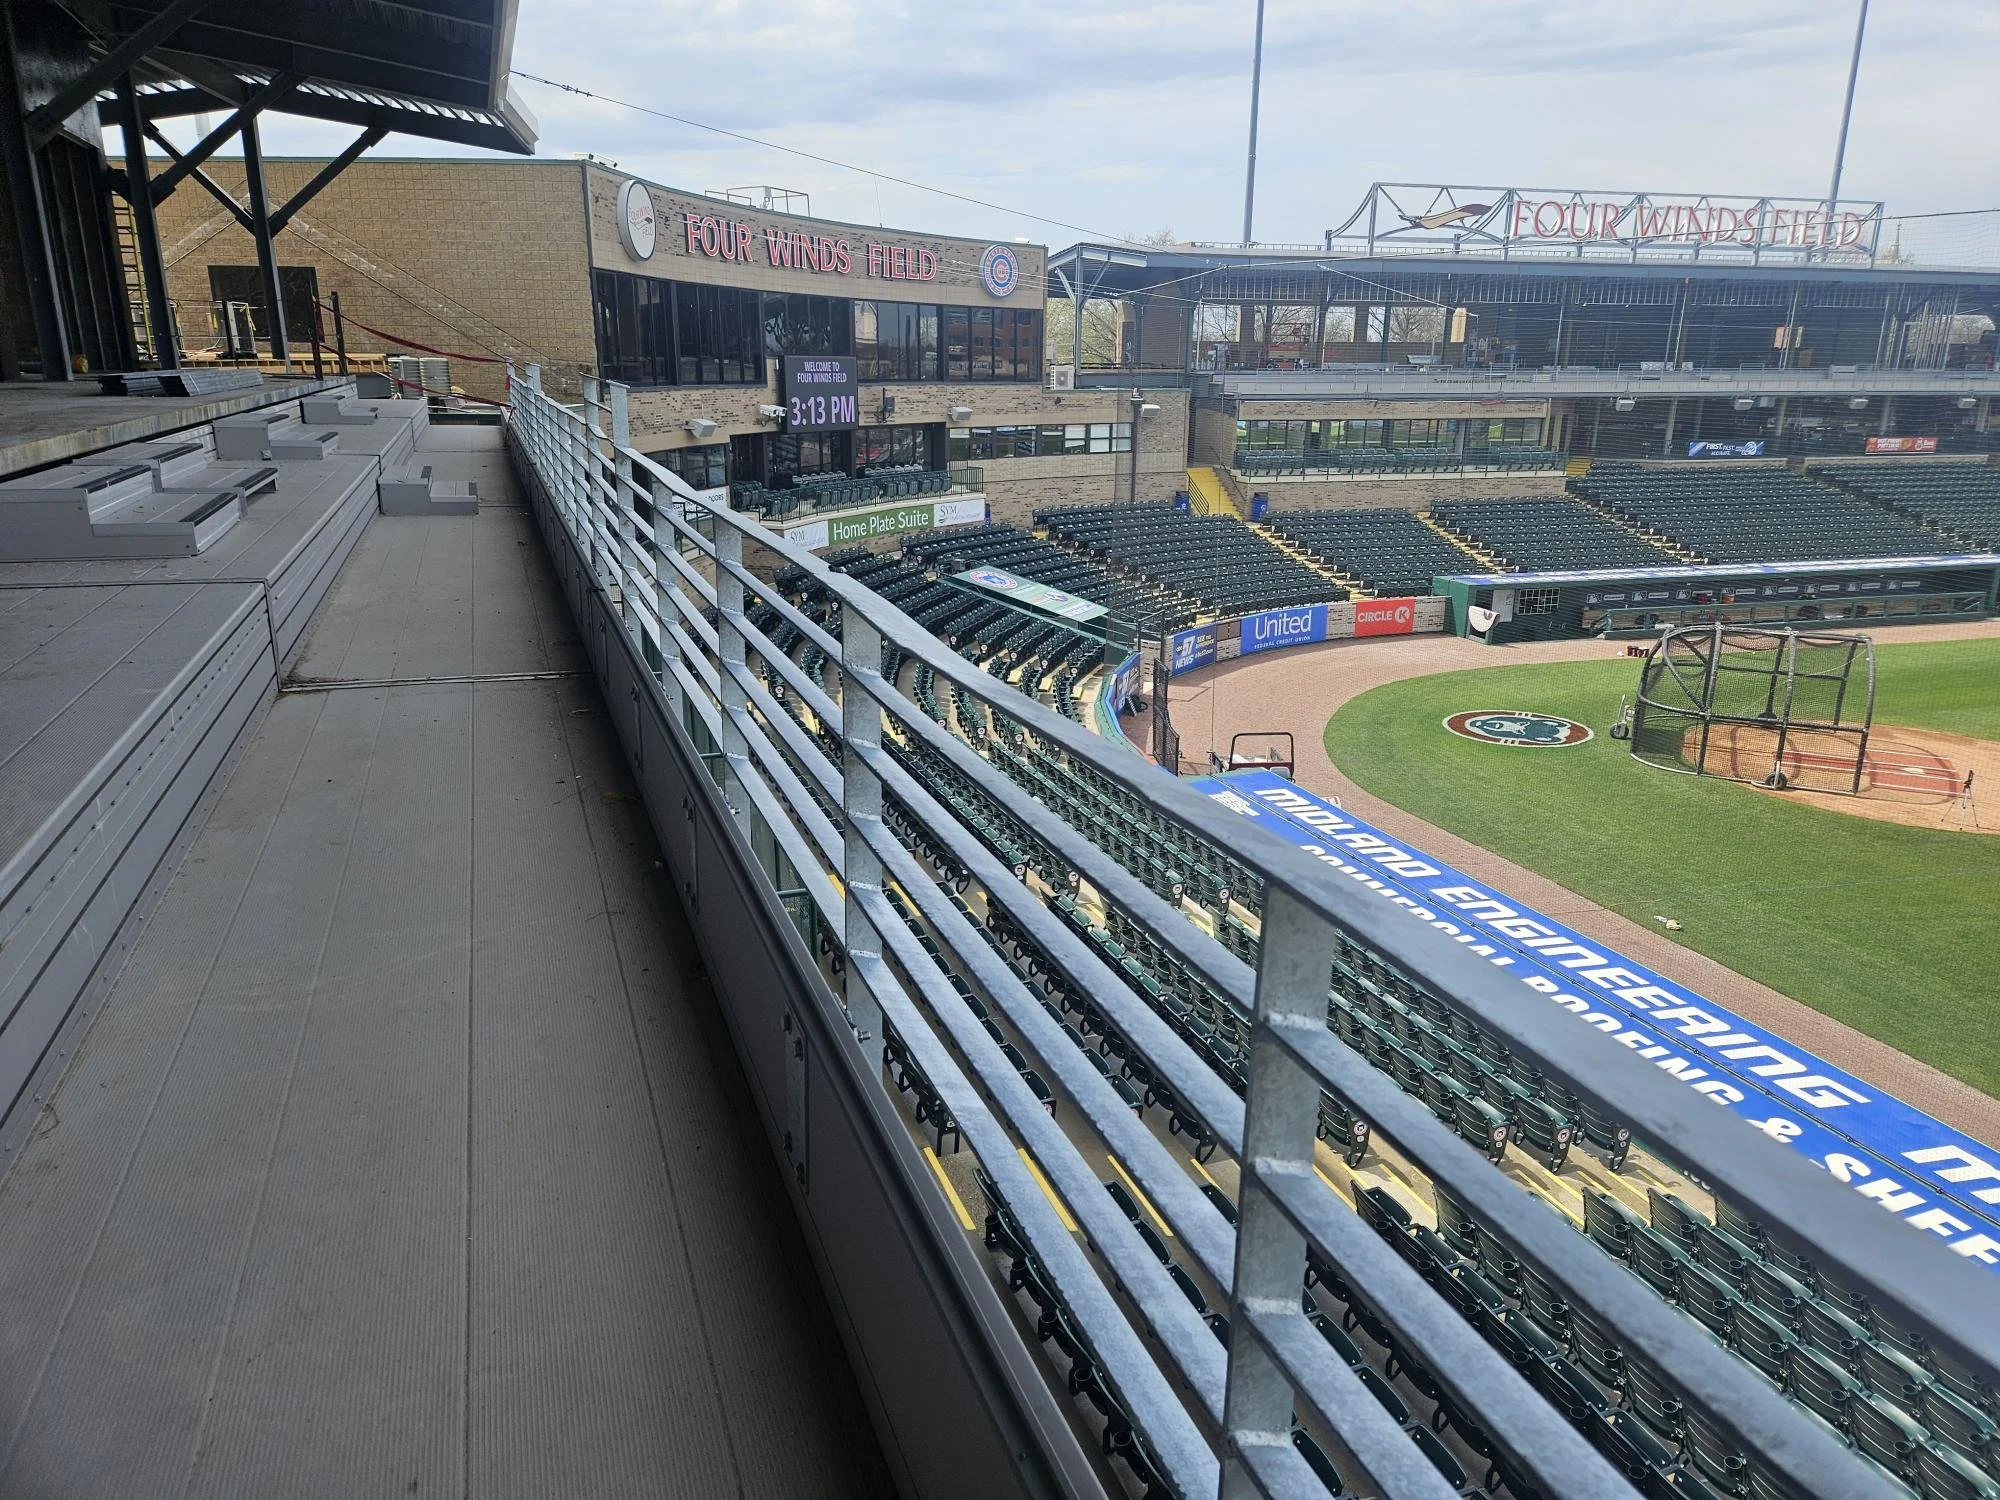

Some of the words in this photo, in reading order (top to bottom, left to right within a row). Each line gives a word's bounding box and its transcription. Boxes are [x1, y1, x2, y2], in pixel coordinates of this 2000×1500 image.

[1511, 200, 1620, 240] FOUR
[1636, 204, 1761, 244] WINDS
[1770, 208, 1862, 247] FIELD
[684, 213, 753, 262] FOUR
[766, 229, 852, 274] WINDS
[867, 243, 937, 281] FIELD
[797, 372, 813, 383] FOUR
[813, 372, 832, 383] WINDS
[832, 372, 847, 383] FIELD
[804, 361, 832, 372] WELCOME
[832, 361, 840, 372] TO
[791, 396, 826, 426] 3:13
[831, 395, 855, 423] PM
[834, 522, 867, 541] Home
[869, 513, 895, 534] Plate
[898, 510, 929, 529] Suite
[1255, 610, 1312, 640] United
[1357, 610, 1393, 623] CIRCLE
[1254, 641, 1275, 650] FEDERAL
[1276, 637, 1293, 646] CREDIT
[1295, 635, 1311, 644] UNION
[1175, 655, 1194, 669] NEWS
[1253, 788, 1442, 878] MIDLAND
[1430, 886, 1871, 1109] ENGINEERING
[1744, 1117, 1803, 1143] &
